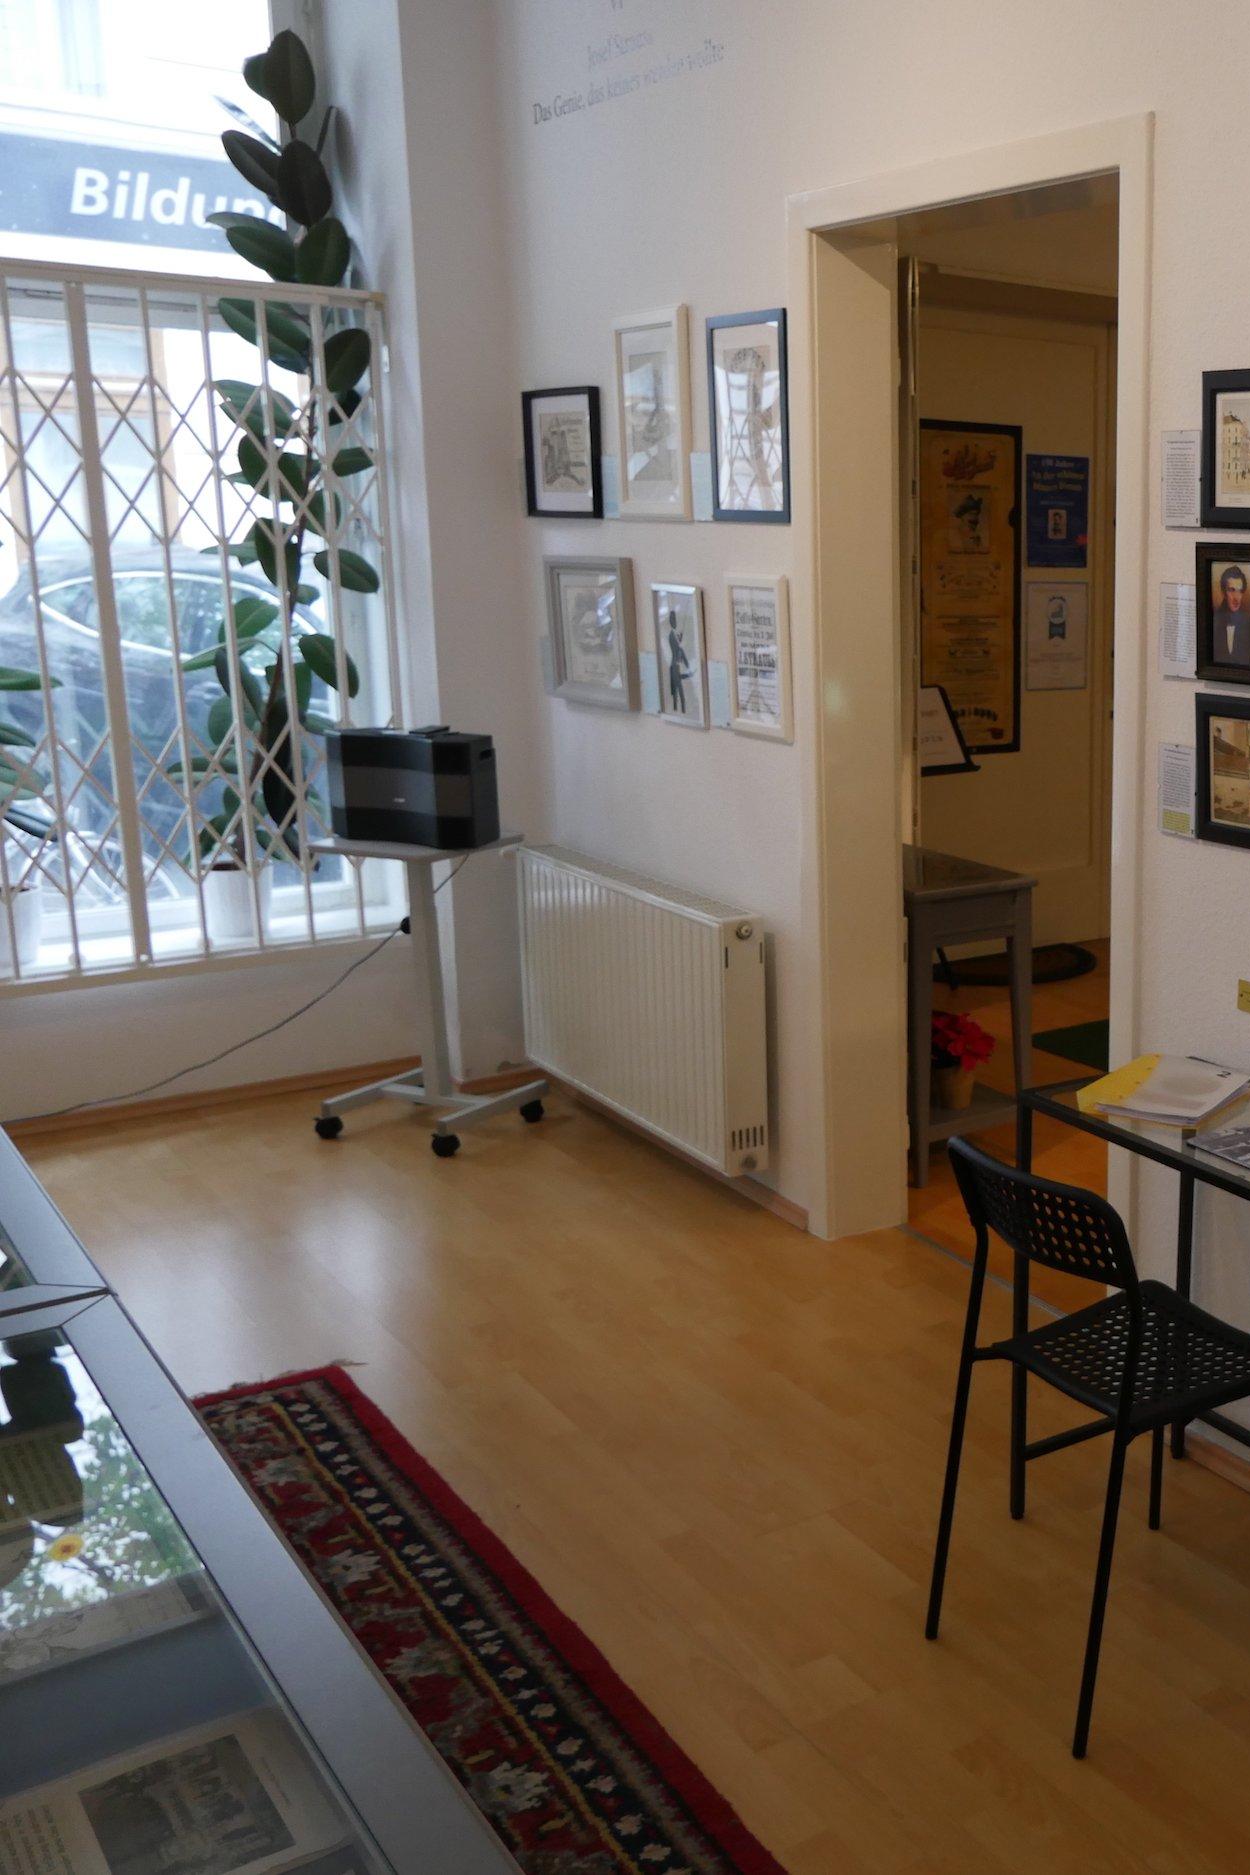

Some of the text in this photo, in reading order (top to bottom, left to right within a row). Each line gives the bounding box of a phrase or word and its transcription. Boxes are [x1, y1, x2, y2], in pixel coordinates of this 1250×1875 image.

[532, 102, 553, 125] Das
[553, 94, 586, 118] Genie,
[587, 81, 605, 107] das
